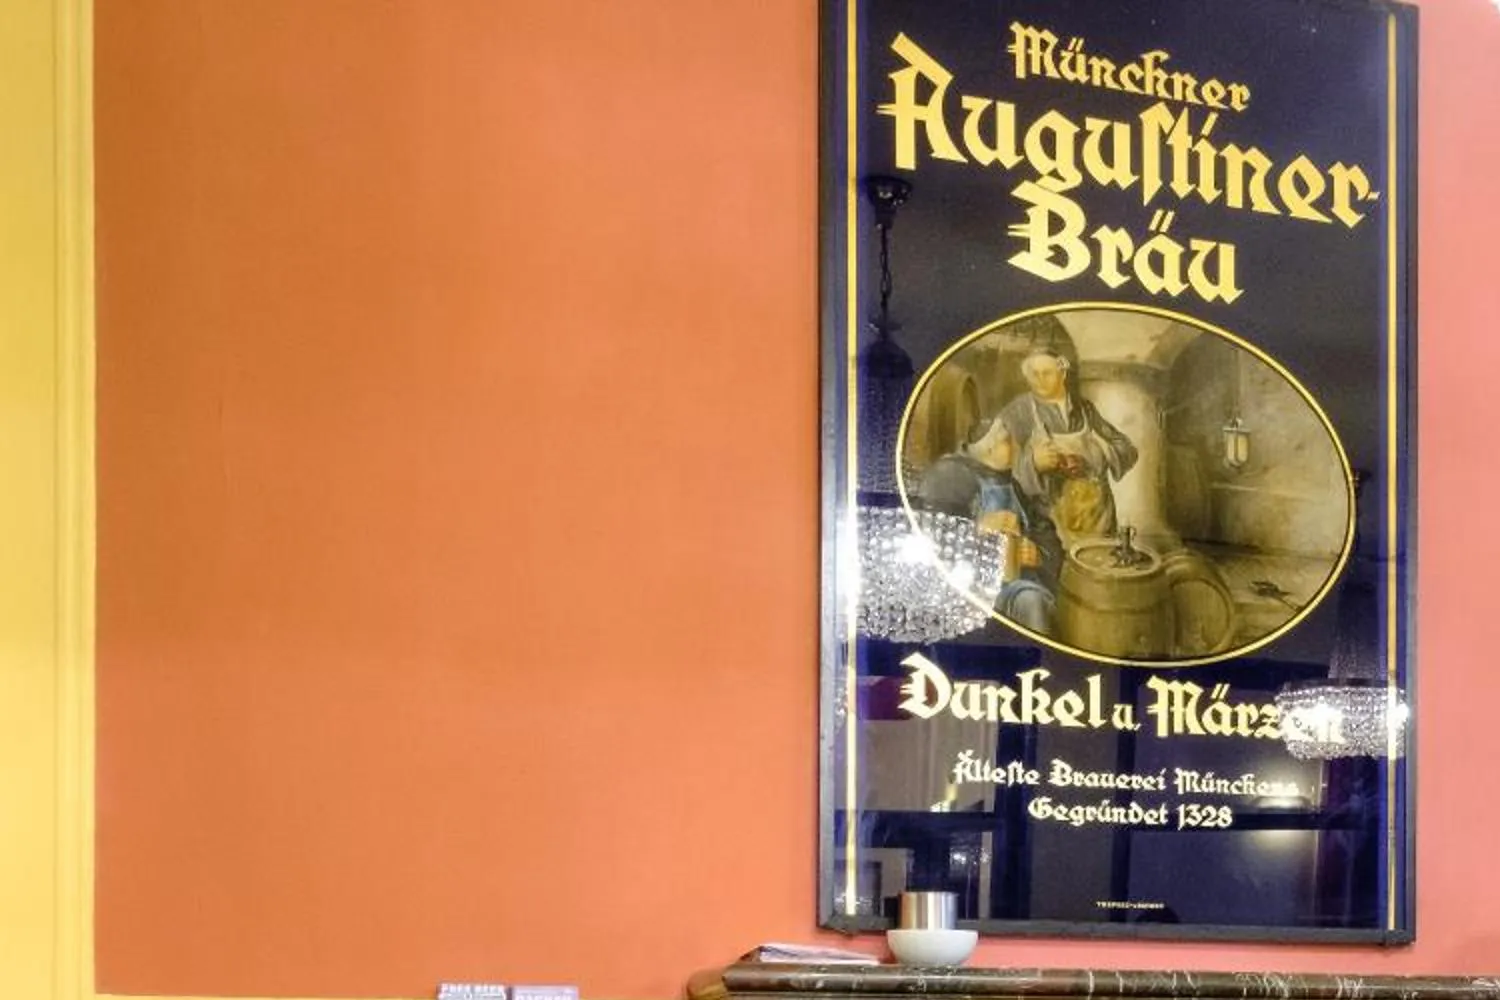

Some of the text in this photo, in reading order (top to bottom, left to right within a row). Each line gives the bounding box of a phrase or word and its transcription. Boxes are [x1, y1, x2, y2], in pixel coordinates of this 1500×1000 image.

[1007, 20, 1251, 113] Münchner
[1007, 180, 1244, 304] Bräu
[897, 651, 1107, 729] Dunkel
[1047, 758, 1167, 790] Brauerei
[1028, 797, 1233, 831] Gegründet 1328
